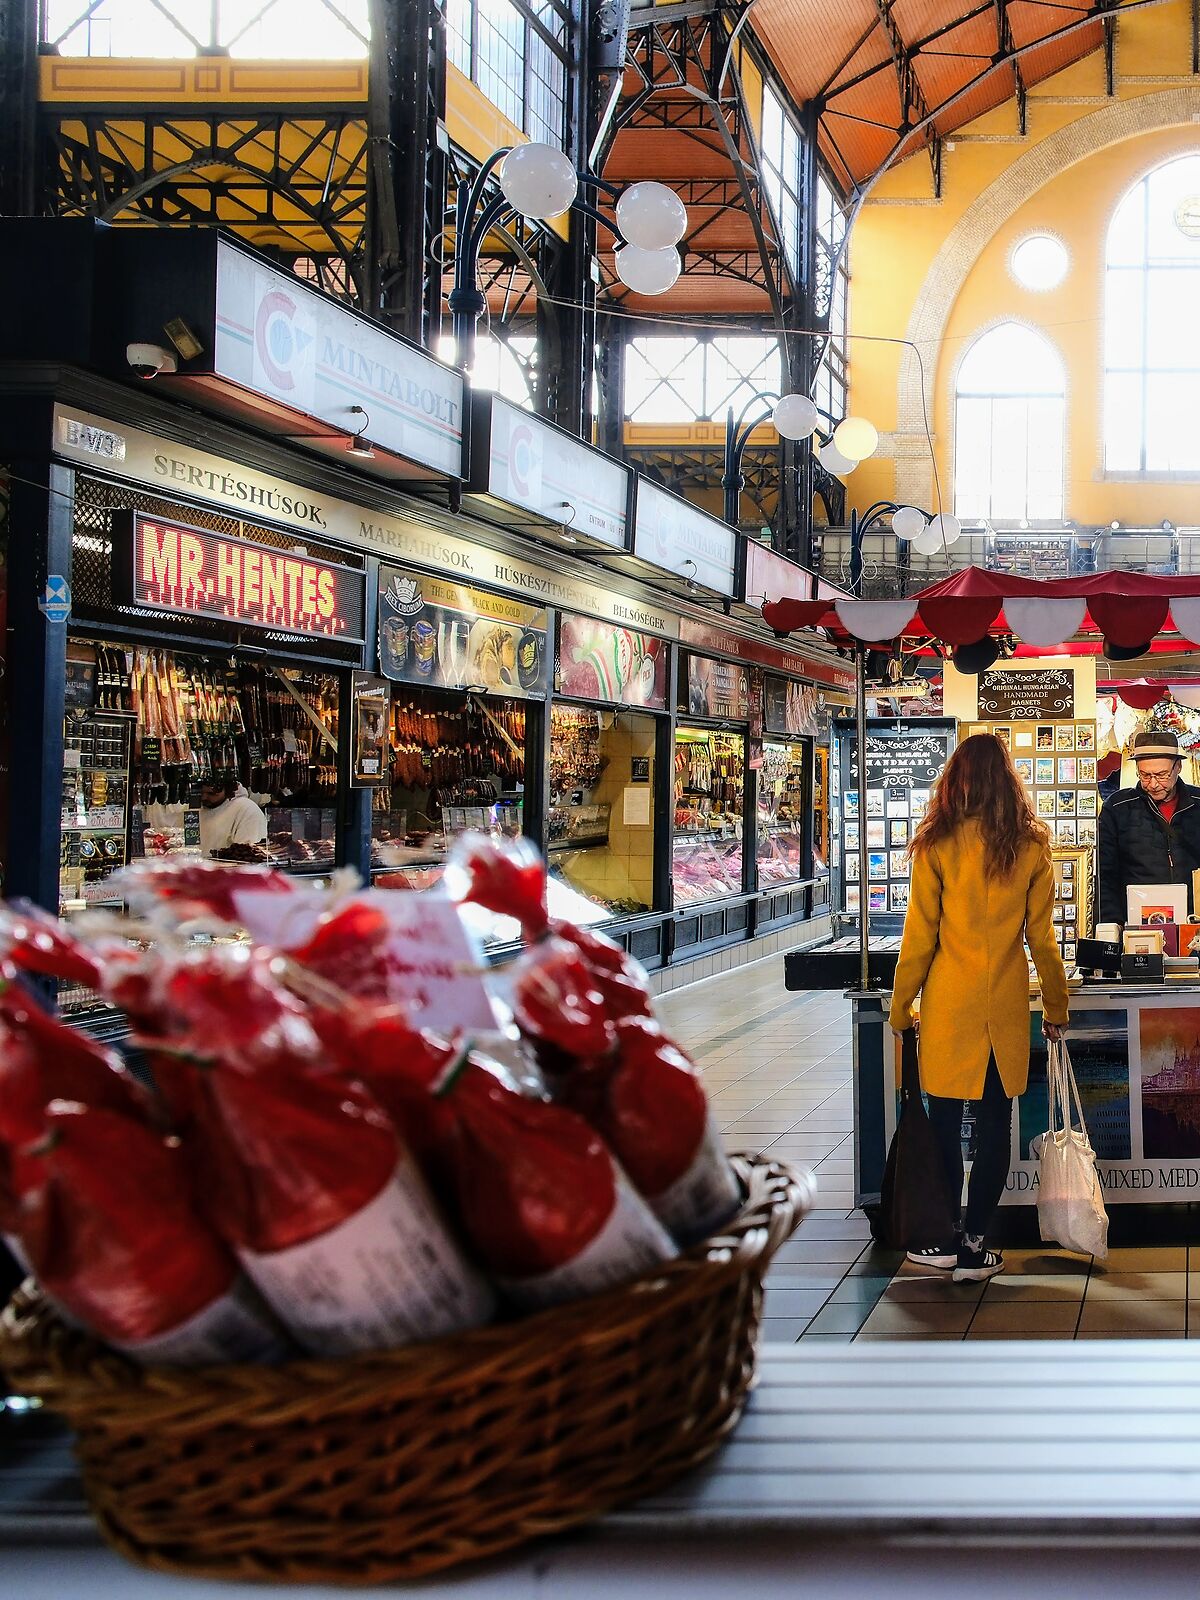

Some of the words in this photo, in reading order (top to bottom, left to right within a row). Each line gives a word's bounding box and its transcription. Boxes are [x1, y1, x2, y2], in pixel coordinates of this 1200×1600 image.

[322, 335, 458, 427] MINTABOLT
[154, 454, 328, 529] SERTÉSHÚSOK,
[359, 521, 474, 573] MARHAHÚSOK,
[494, 564, 600, 612] HÚSKÉSZÍTMÉNYEK,
[431, 584, 444, 597] THE
[492, 601, 503, 614] AND
[505, 604, 521, 618] GOLD
[1003, 691, 1049, 699] HANDMADE
[1100, 1168, 1154, 1190] MIXED
